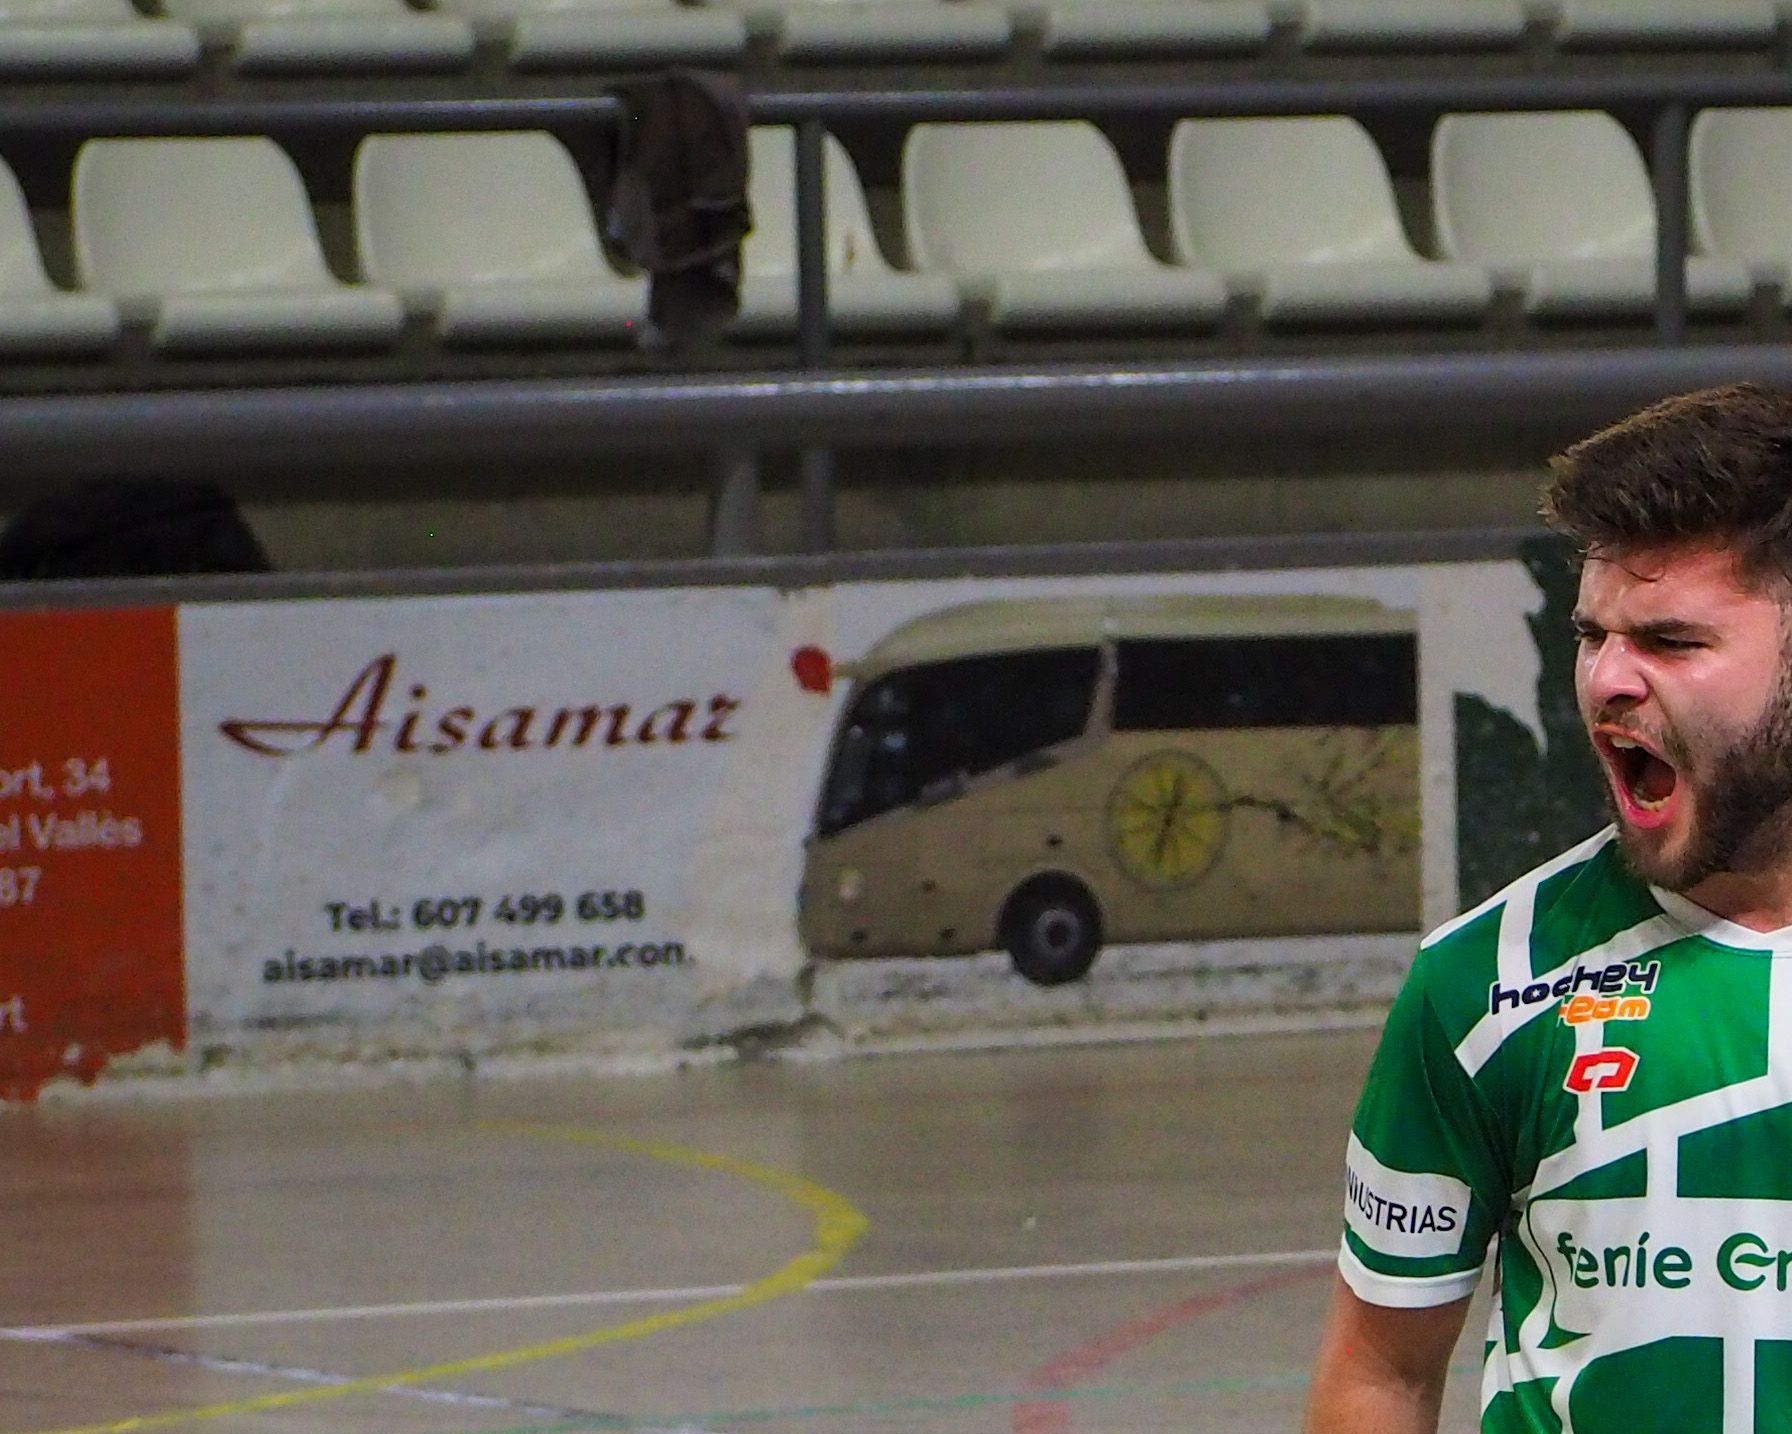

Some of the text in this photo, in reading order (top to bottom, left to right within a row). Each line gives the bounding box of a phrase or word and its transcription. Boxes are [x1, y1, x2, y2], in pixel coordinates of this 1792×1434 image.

[218, 652, 742, 756] Aisamar
[62, 757, 111, 797] 34
[411, 897, 483, 929] 607
[494, 894, 566, 924] 499
[576, 889, 647, 921] 658
[1556, 1230, 1693, 1289] feníe
